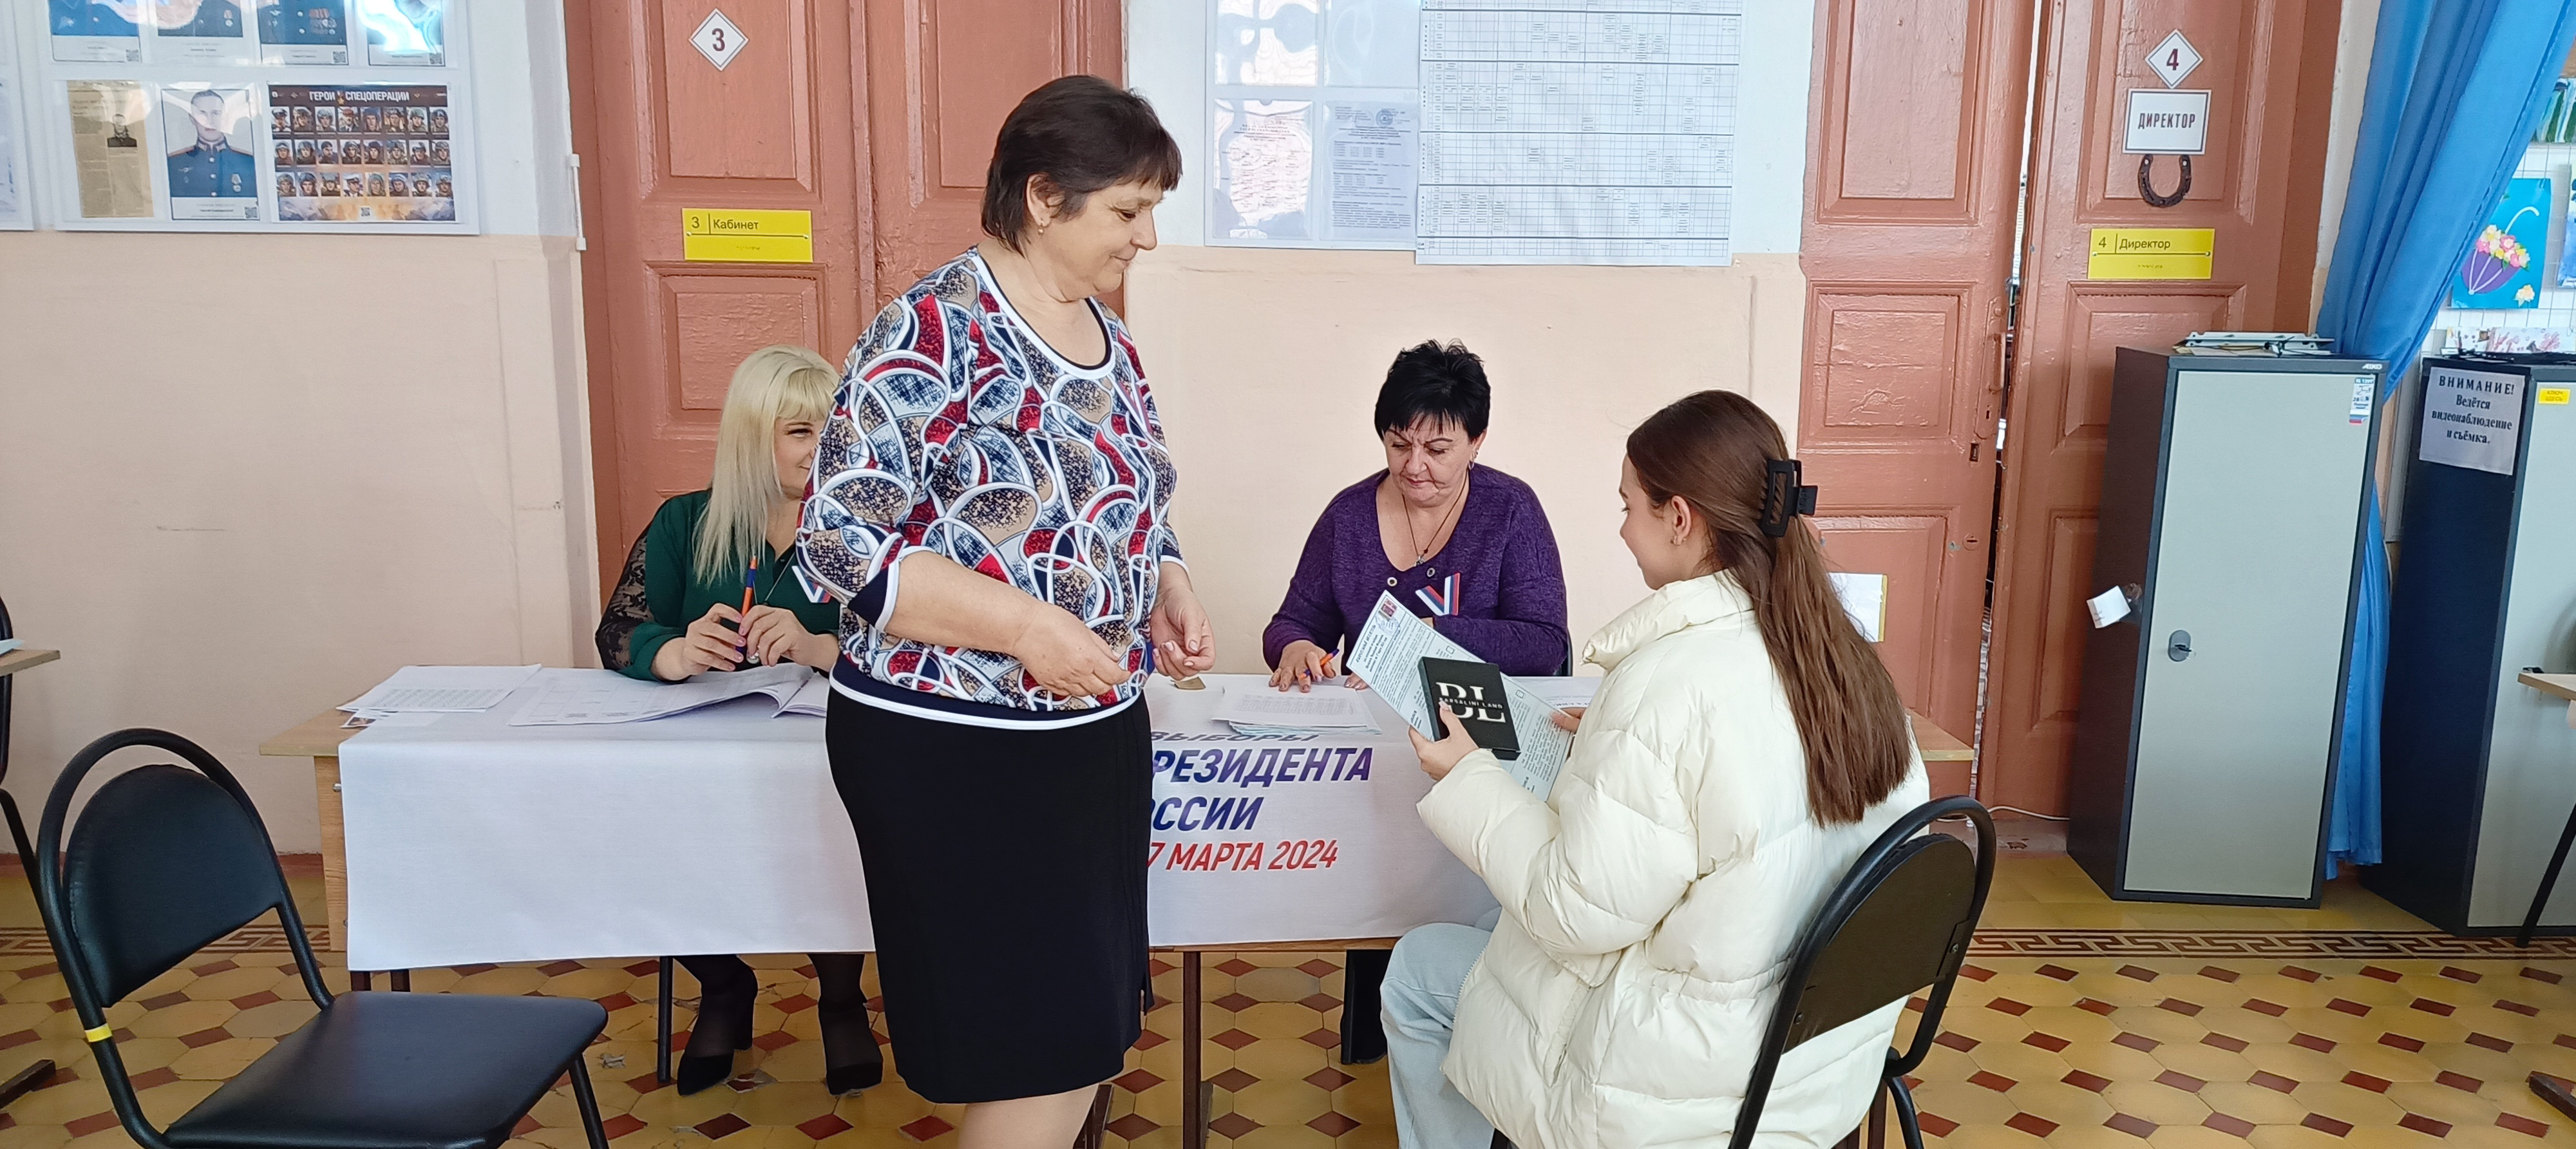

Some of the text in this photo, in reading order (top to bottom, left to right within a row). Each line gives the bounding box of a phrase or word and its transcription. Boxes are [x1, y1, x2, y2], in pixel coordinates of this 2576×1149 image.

[711, 28, 726, 52] 3
[2166, 48, 2179, 71] 4
[309, 91, 410, 102] ГЕРОИ СПЕЦОПЕРАЦИИ
[2137, 113, 2196, 129] ДИРЕКТОР
[691, 216, 700, 229] 3
[713, 219, 759, 230] Кабинет
[2098, 236, 2107, 248] 4
[2119, 238, 2171, 251] Директор
[2439, 375, 2515, 395] ВНИМАНИЕ!
[2456, 394, 2490, 410] Ведётся
[2432, 410, 2512, 430] видеонаблюдение
[2447, 430, 2490, 444] и съёмка.
[1153, 747, 1373, 788] РЕЗИДЕНТА
[1147, 840, 1338, 871] 7 МАРТА 2024
